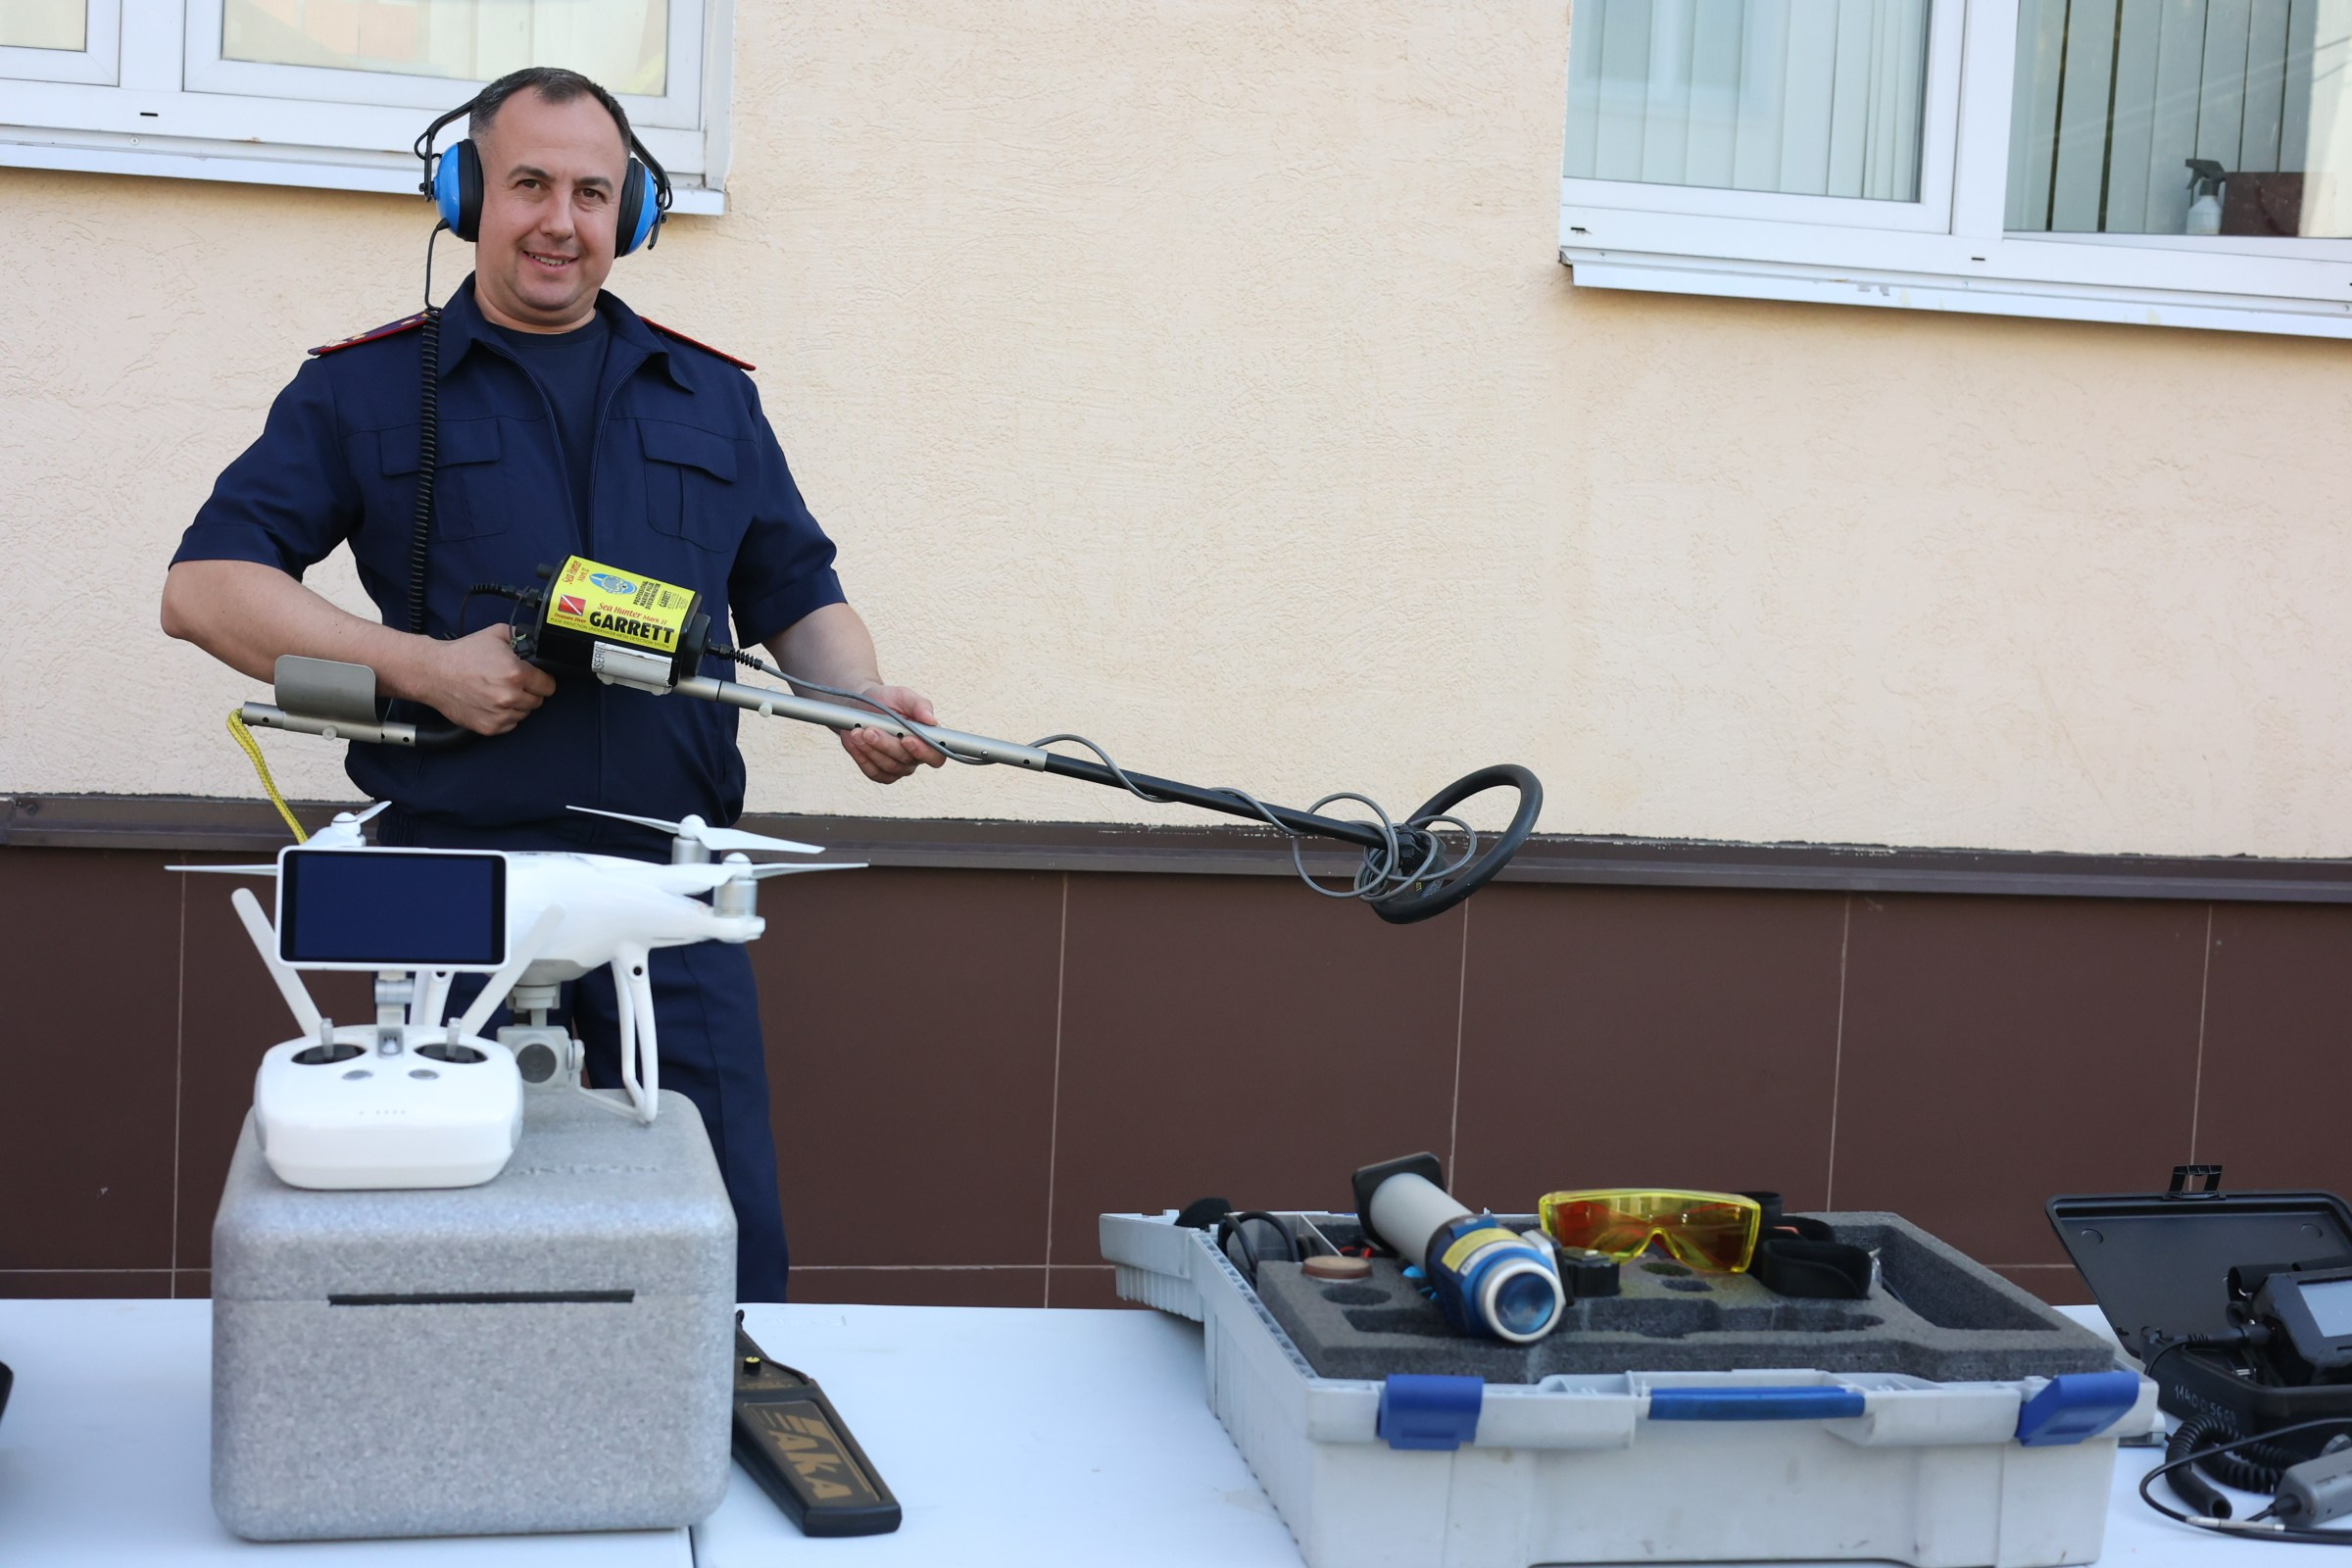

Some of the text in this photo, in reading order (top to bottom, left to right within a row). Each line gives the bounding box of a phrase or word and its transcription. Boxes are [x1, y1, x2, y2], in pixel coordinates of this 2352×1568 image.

[563, 573, 575, 584] Sea
[598, 603, 612, 612] Sea
[614, 606, 642, 618] Hunter
[643, 614, 660, 623] Mark
[589, 612, 675, 644] GARRETT
[768, 1430, 853, 1499] AKA
